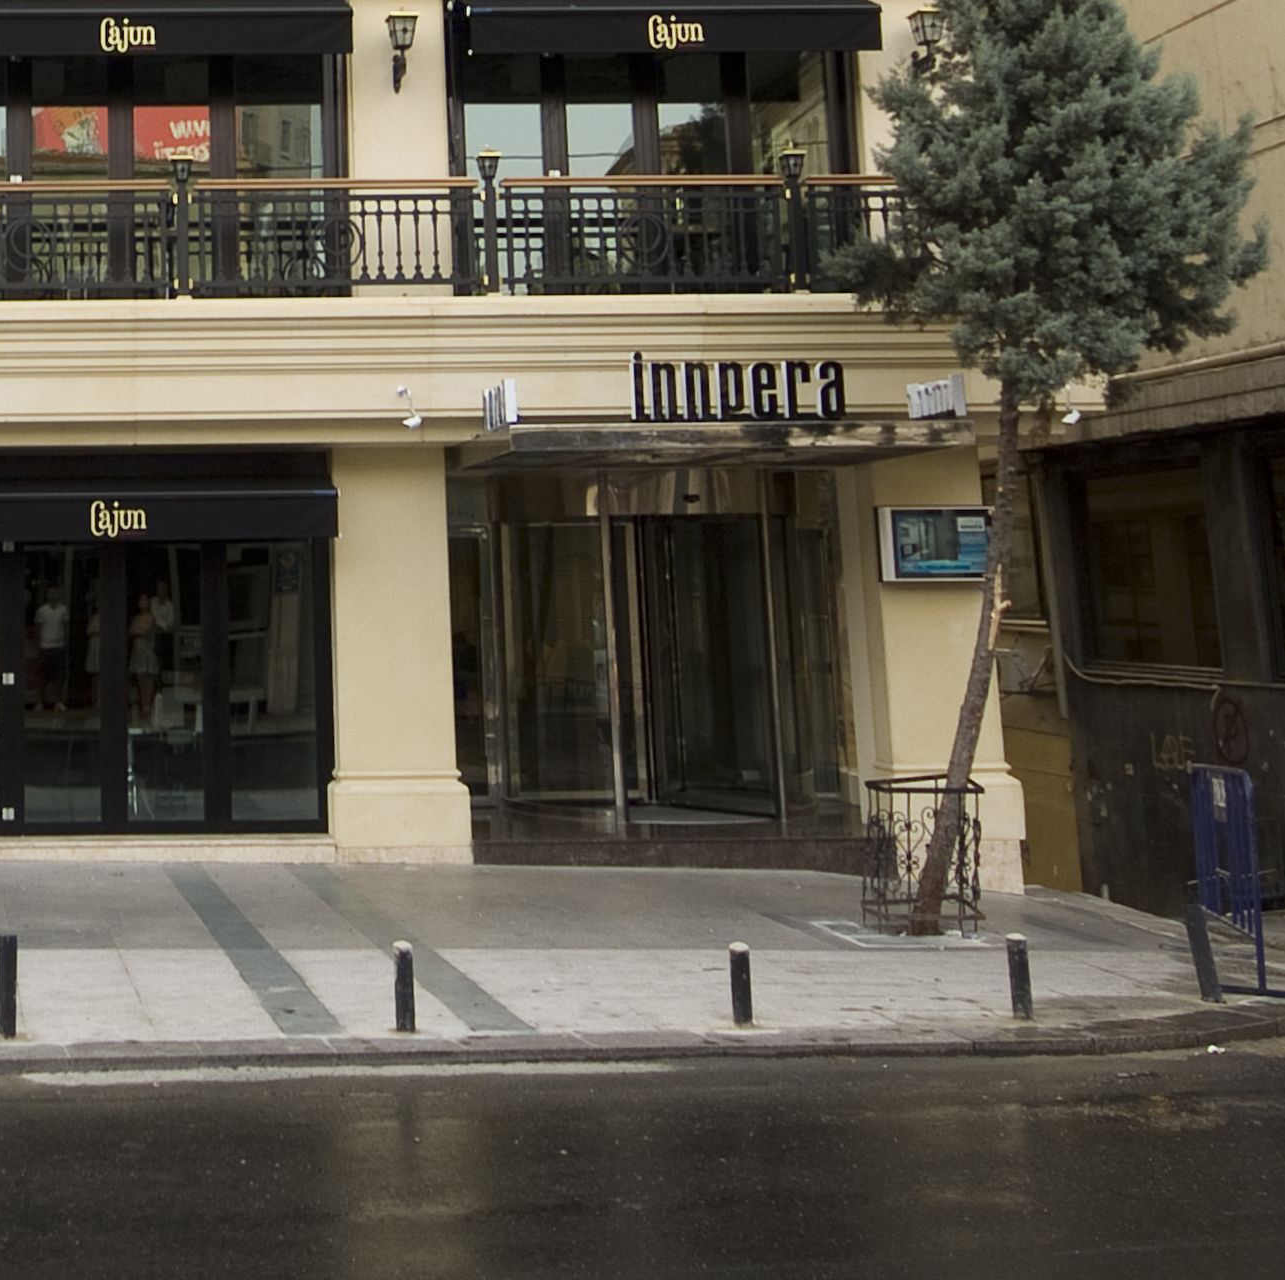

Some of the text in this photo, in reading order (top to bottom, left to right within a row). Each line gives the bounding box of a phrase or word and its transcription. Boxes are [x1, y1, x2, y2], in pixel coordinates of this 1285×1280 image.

[99, 17, 156, 53] Cajun
[648, 14, 704, 50] Cajun
[629, 350, 846, 420] innpera
[90, 500, 147, 538] Cajun
